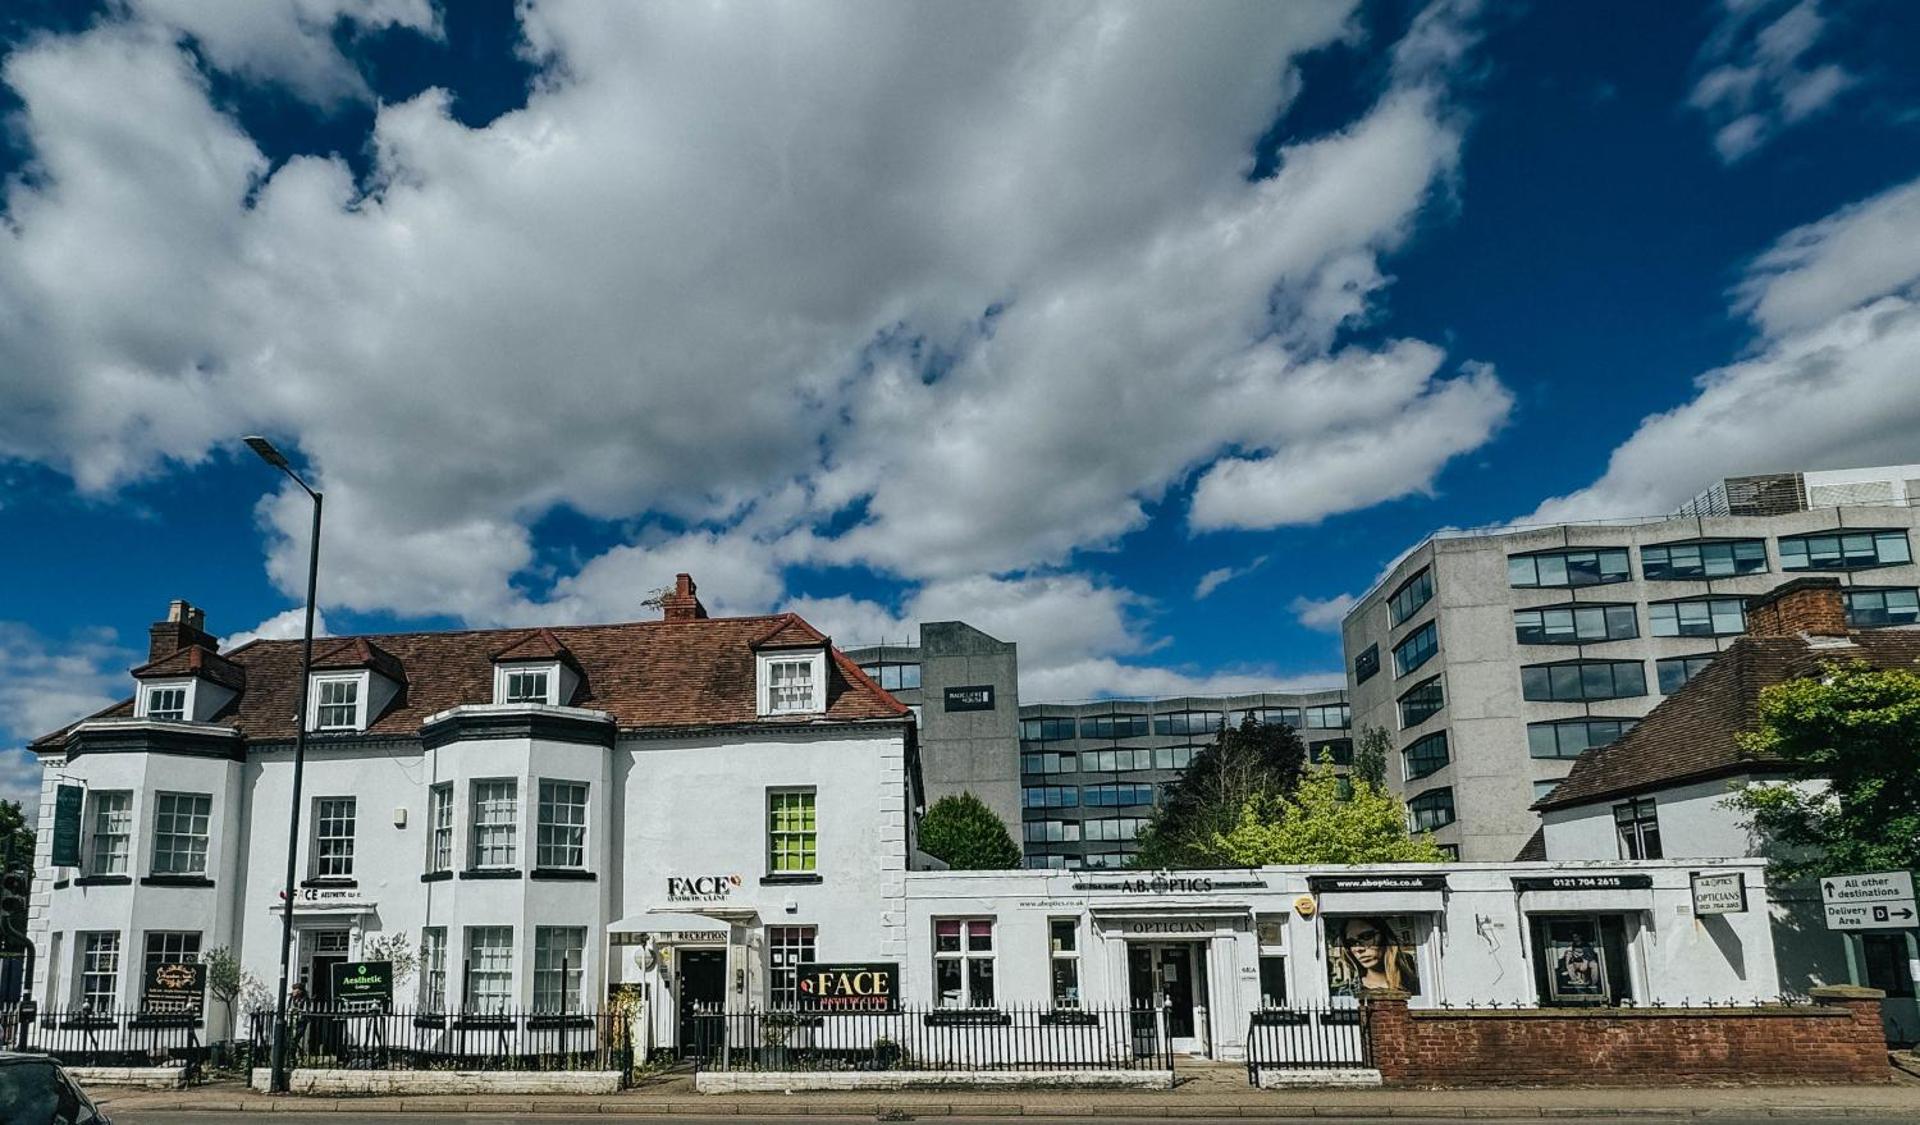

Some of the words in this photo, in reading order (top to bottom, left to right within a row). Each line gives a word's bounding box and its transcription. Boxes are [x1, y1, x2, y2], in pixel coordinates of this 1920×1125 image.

[667, 876, 730, 896] FACE
[1336, 878, 1423, 888] www.aboptics.co.uk
[1553, 879, 1576, 887] 0121
[1577, 878, 1596, 886] 704
[1597, 877, 1620, 886] 2615
[1844, 880, 1858, 888] All
[1861, 878, 1889, 887] other
[1696, 892, 1740, 902] OPTICIANS
[1838, 888, 1900, 898] destinations
[1828, 906, 1867, 916] Delivery
[1838, 916, 1861, 925] Area
[1133, 921, 1207, 933] OPTICIAN
[678, 931, 728, 940] RECEPTION
[342, 975, 382, 985] Aesthetic
[818, 971, 889, 995] FACE
